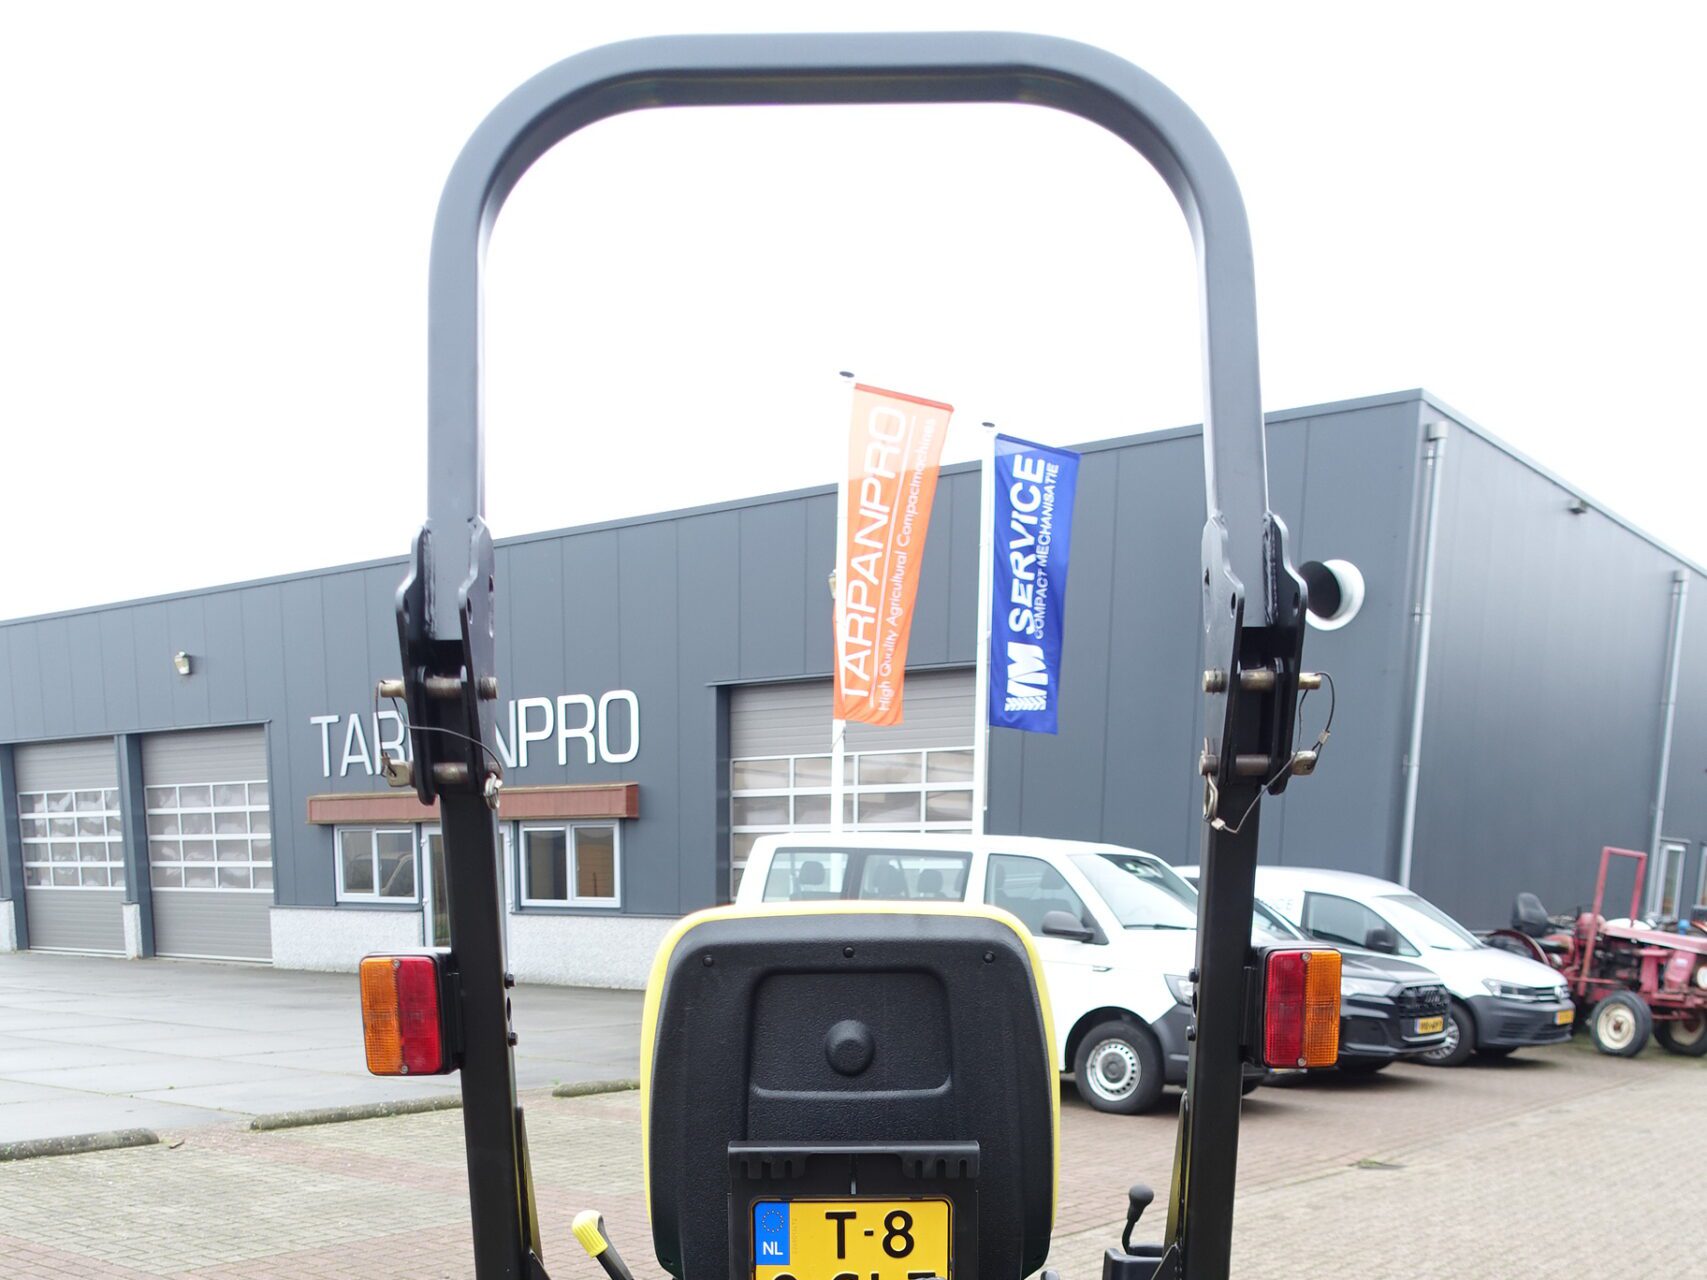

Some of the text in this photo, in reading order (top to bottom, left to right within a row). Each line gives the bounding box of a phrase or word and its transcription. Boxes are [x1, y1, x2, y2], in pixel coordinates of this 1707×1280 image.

[844, 405, 906, 698] TARPANPRO
[1009, 455, 1045, 635] SERVICE
[1034, 463, 1059, 640] COMPACT MECHANISATIE
[887, 551, 908, 626] Agricultural
[880, 628, 898, 677] Quality
[310, 689, 640, 778] TARNPRO
[878, 681, 893, 712] High
[762, 1241, 783, 1256] NL
[826, 1210, 915, 1259] T-8
